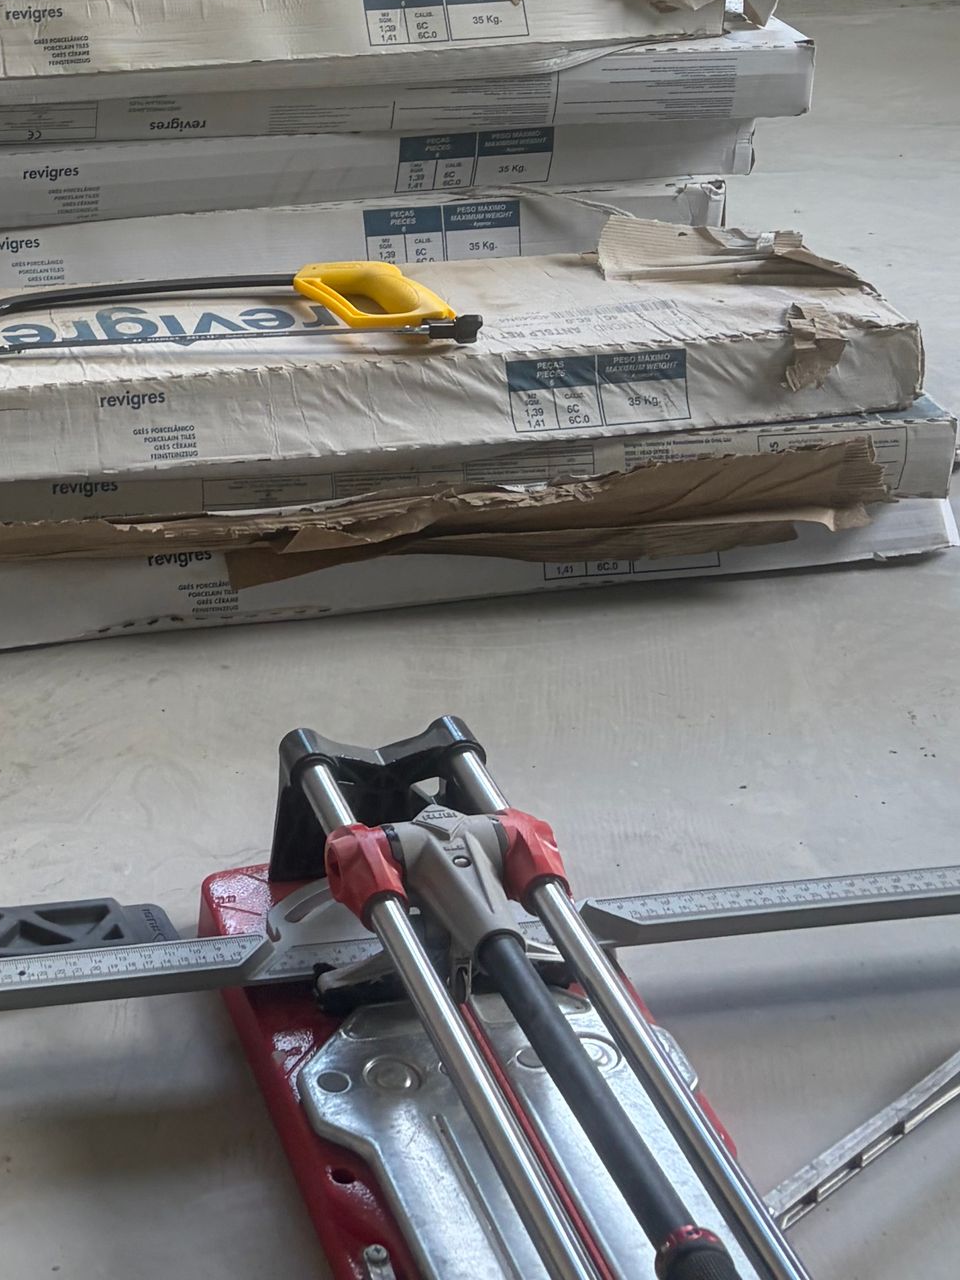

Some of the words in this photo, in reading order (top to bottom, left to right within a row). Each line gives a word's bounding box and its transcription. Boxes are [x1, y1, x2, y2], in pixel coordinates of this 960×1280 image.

[5, 6, 63, 23] revigres
[472, 16, 484, 24] 35
[486, 15, 502, 25] Kg.
[379, 25, 396, 33] 1,39
[416, 22, 428, 30] 6C
[381, 34, 397, 42] 1,41
[418, 31, 437, 40] 6C.0
[149, 118, 207, 132] revigres
[23, 165, 79, 181] revigres
[498, 165, 510, 173] 35
[512, 164, 527, 173] Kg.
[408, 174, 425, 182] 1,39
[477, 203, 506, 211] MÁXIMO
[390, 210, 414, 218] PEÇAS
[450, 213, 485, 221] MAXIMUM
[485, 211, 513, 219] WEIGHT
[469, 242, 480, 251] 35
[482, 241, 498, 251] Kg.
[379, 251, 396, 259] 1,39
[415, 248, 427, 256] 6C
[536, 361, 565, 369] PEÇAS
[613, 356, 636, 364] PESO
[605, 363, 645, 373] MAXIMUM
[645, 360, 678, 370] WEIGHT
[100, 390, 166, 410] revigres
[628, 397, 641, 407] 35
[644, 395, 661, 406] Kg.
[525, 407, 544, 417] 1,39
[567, 404, 580, 413] 6C
[527, 419, 546, 428] 1,41
[568, 415, 590, 424] 6C.0
[144, 435, 179, 443] PORCELAIN
[150, 450, 198, 460] FEINSTEINZEUG
[52, 478, 118, 497] revigres
[556, 565, 573, 575] 1,41
[597, 562, 618, 571] 6C.0
